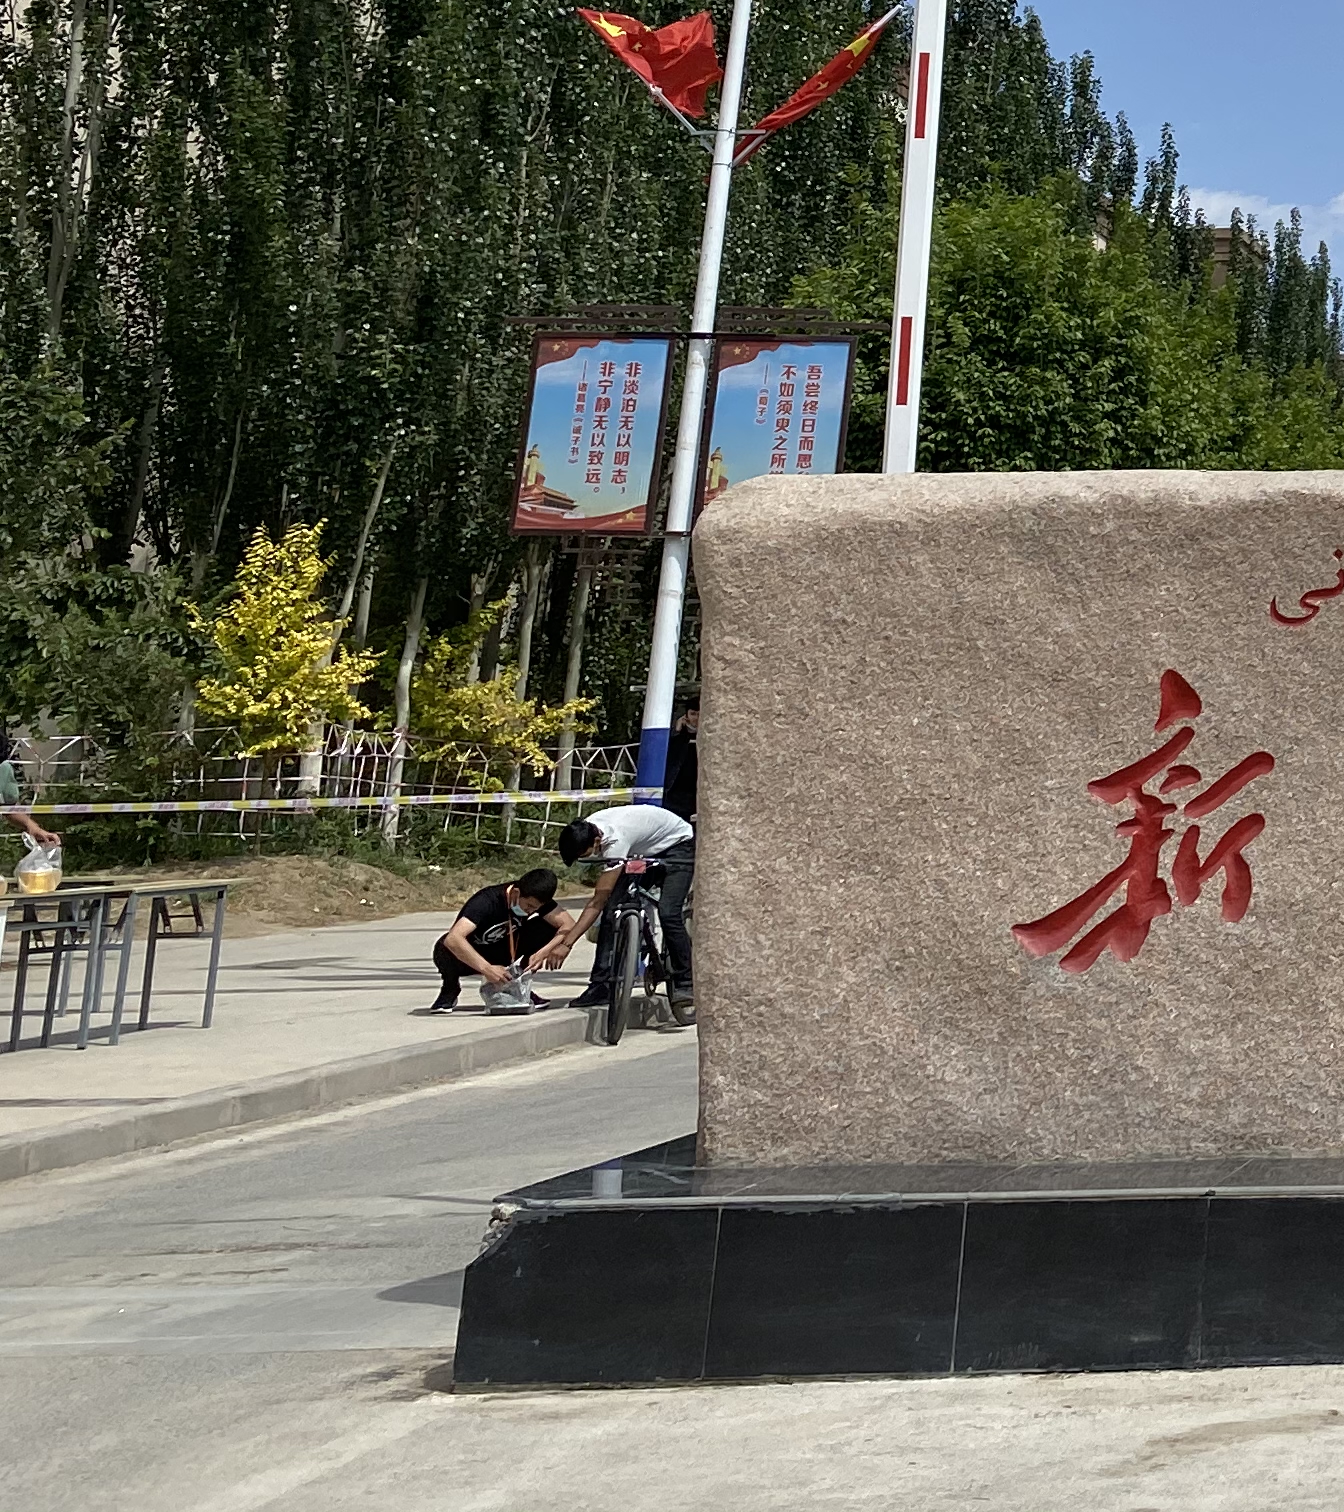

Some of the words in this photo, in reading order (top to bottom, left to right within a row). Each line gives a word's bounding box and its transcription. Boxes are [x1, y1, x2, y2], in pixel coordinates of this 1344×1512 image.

[585, 362, 616, 493] 非宁静无以致远。
[611, 362, 642, 494] 非淡泊无以明志，
